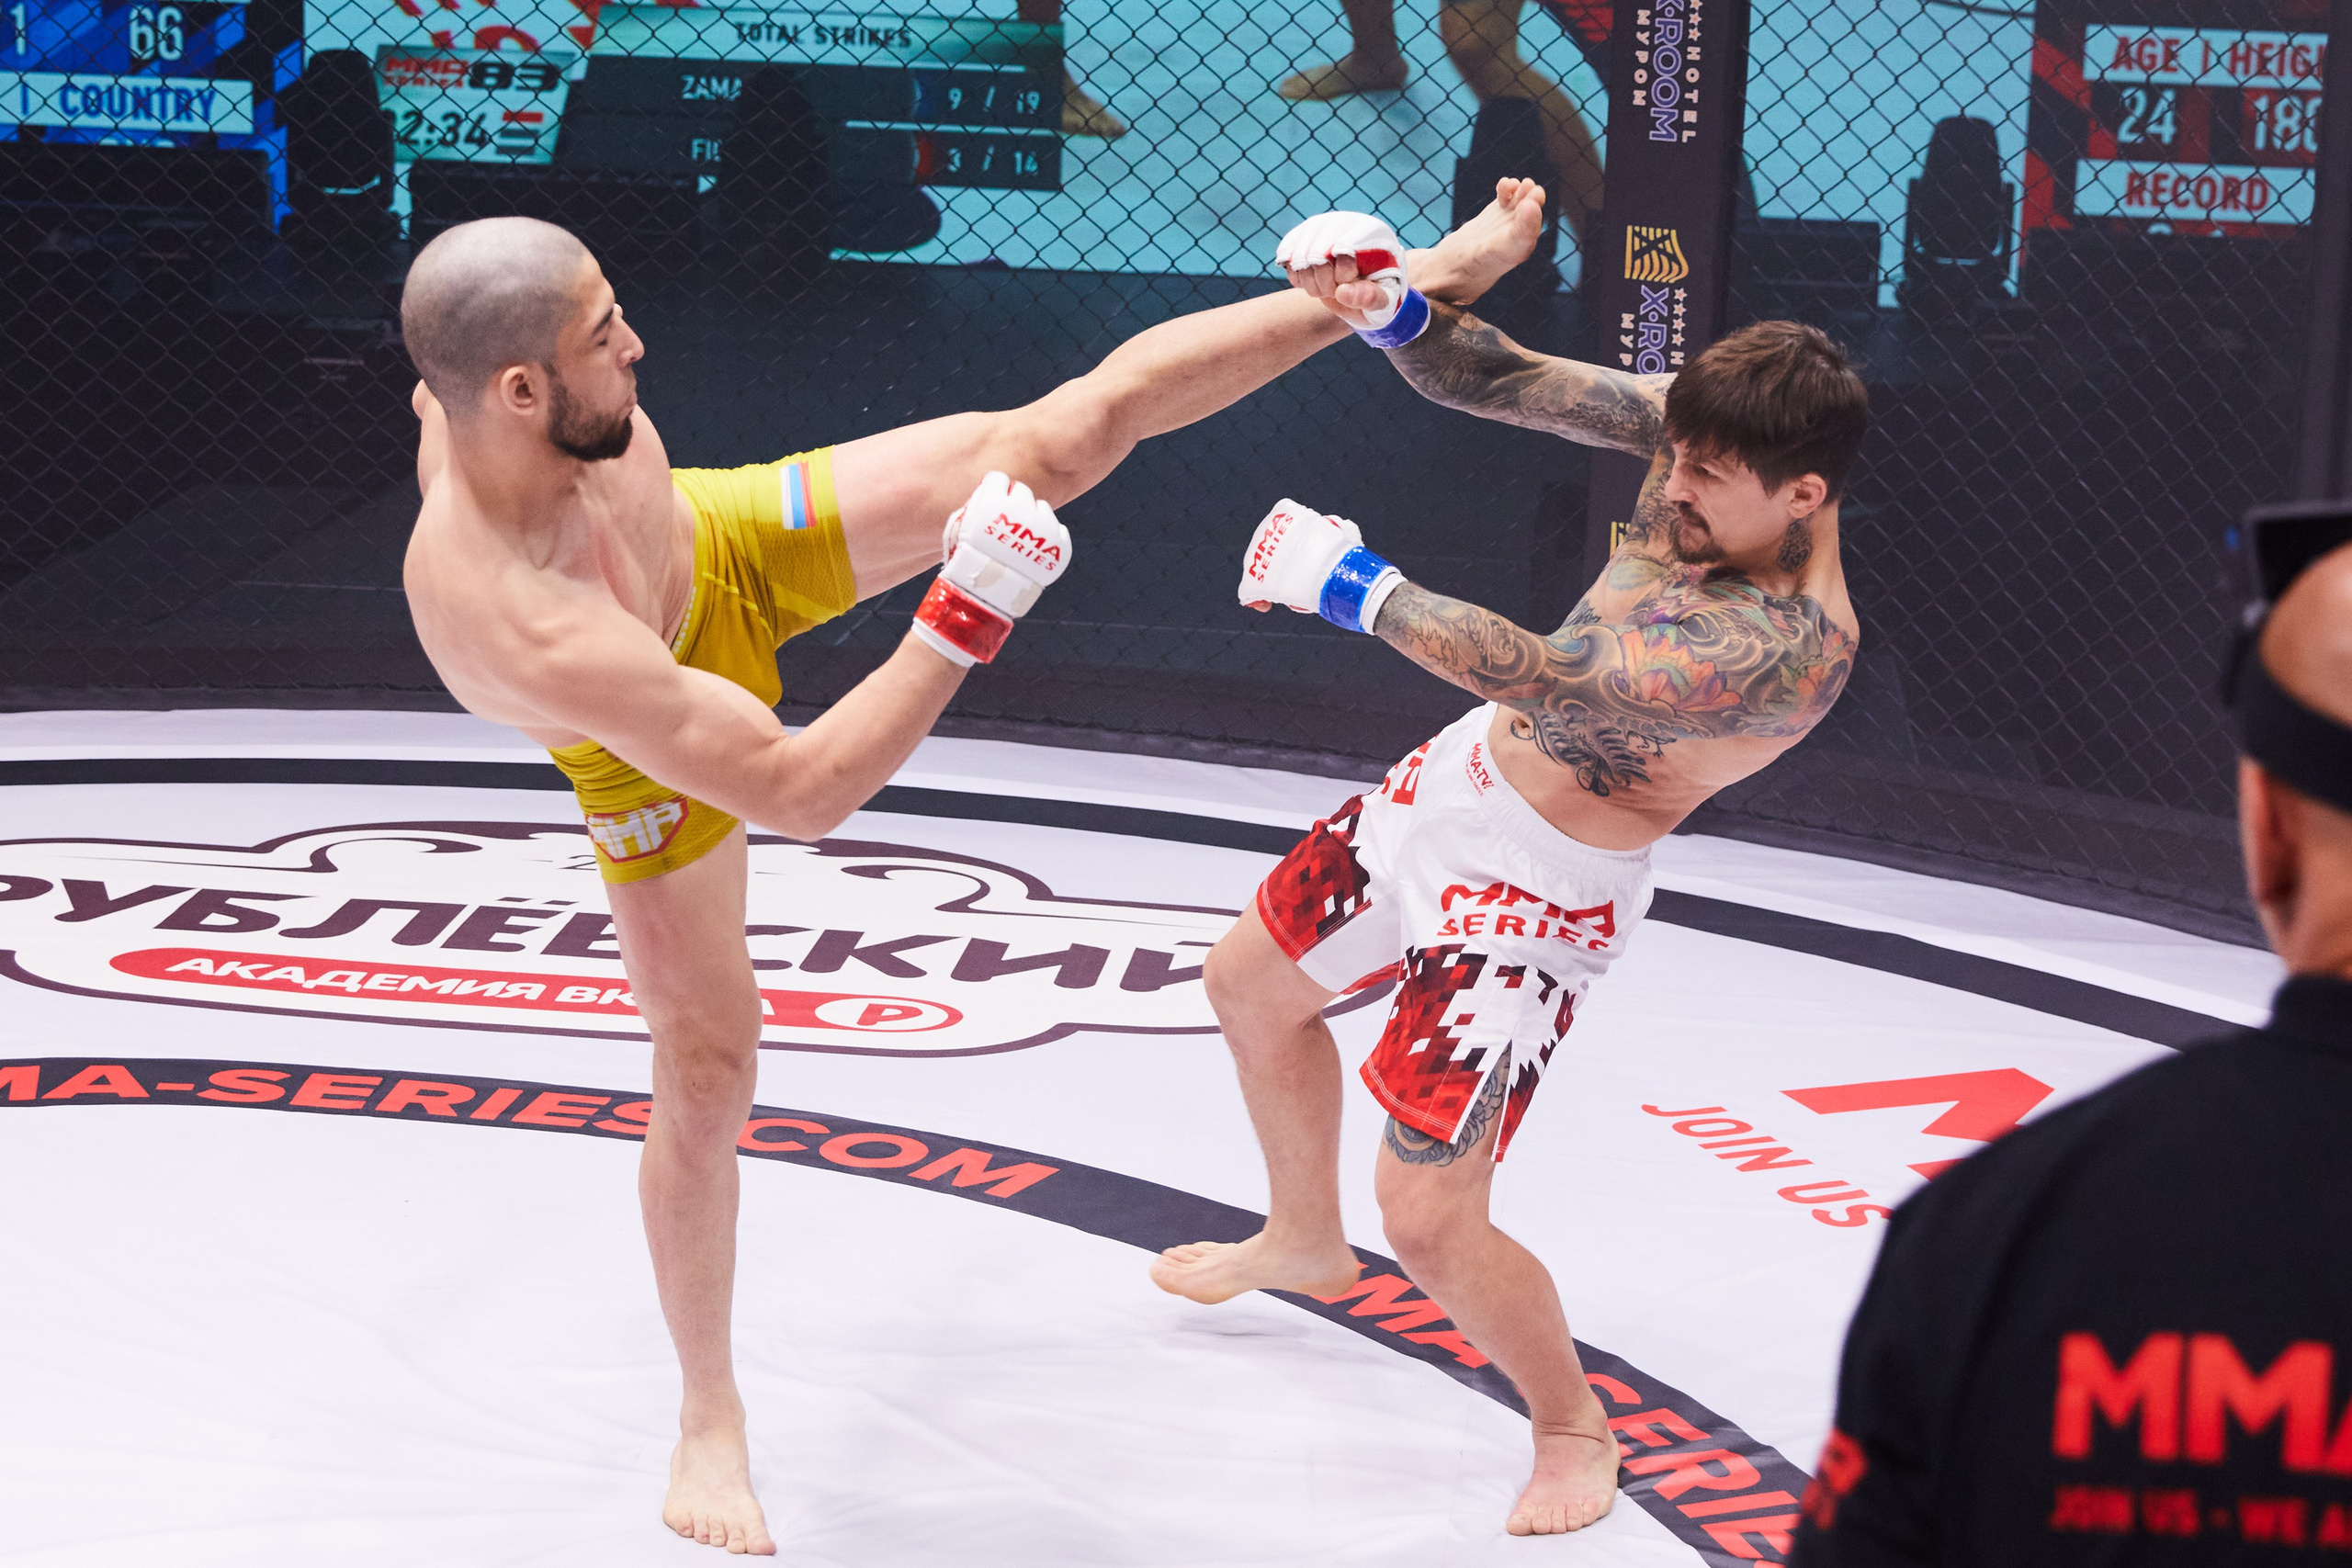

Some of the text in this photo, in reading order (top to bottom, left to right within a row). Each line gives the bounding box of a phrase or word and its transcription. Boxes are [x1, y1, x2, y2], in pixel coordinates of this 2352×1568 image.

[129, 6, 184, 61] 66
[735, 22, 912, 47] TOTAL STRIKES
[2110, 36, 2182, 73] AGE
[59, 83, 216, 121] COUNTRY
[948, 87, 962, 110] 9
[1015, 91, 1040, 115] 19
[1681, 46, 1702, 143] HOTEL
[2117, 88, 2177, 145] 24
[947, 148, 962, 173] 3
[2124, 172, 2271, 212] RECORD
[984, 525, 1057, 571] SERIES
[993, 513, 1062, 562] MMA
[1249, 513, 1287, 579] MMA
[1257, 514, 1294, 583] SERIES
[165, 957, 547, 1001] АКАДЕМИЯ
[1641, 1104, 1815, 1172] JOIN
[1777, 1179, 1894, 1227] US
[2050, 1330, 2352, 1476] MM
